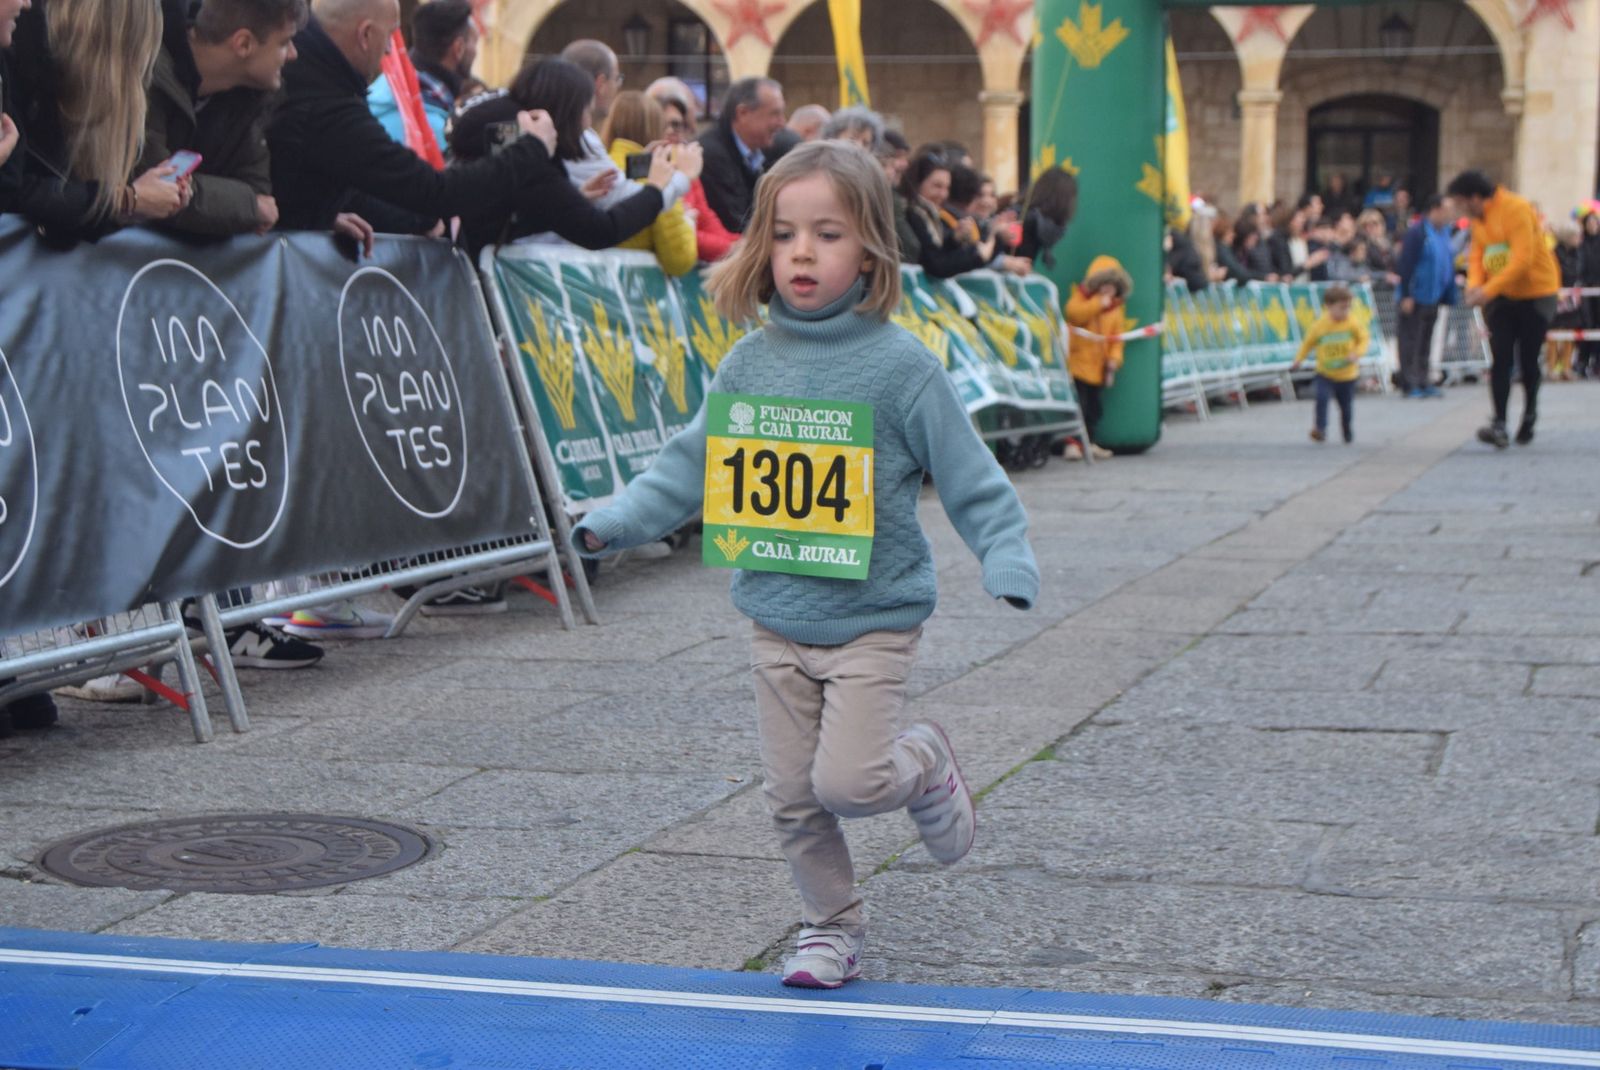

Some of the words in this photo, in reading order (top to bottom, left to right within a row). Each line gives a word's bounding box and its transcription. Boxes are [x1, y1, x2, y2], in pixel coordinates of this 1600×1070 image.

[152, 315, 226, 363] IM
[360, 315, 417, 358] IM
[759, 404, 853, 427] FUNDACION
[759, 420, 794, 439] CAJA
[798, 424, 853, 442] RURAL
[181, 440, 268, 493] TES
[386, 425, 452, 470] TES
[722, 446, 851, 523] 1304
[751, 540, 795, 561] CAJA
[798, 544, 861, 566] RURAL
